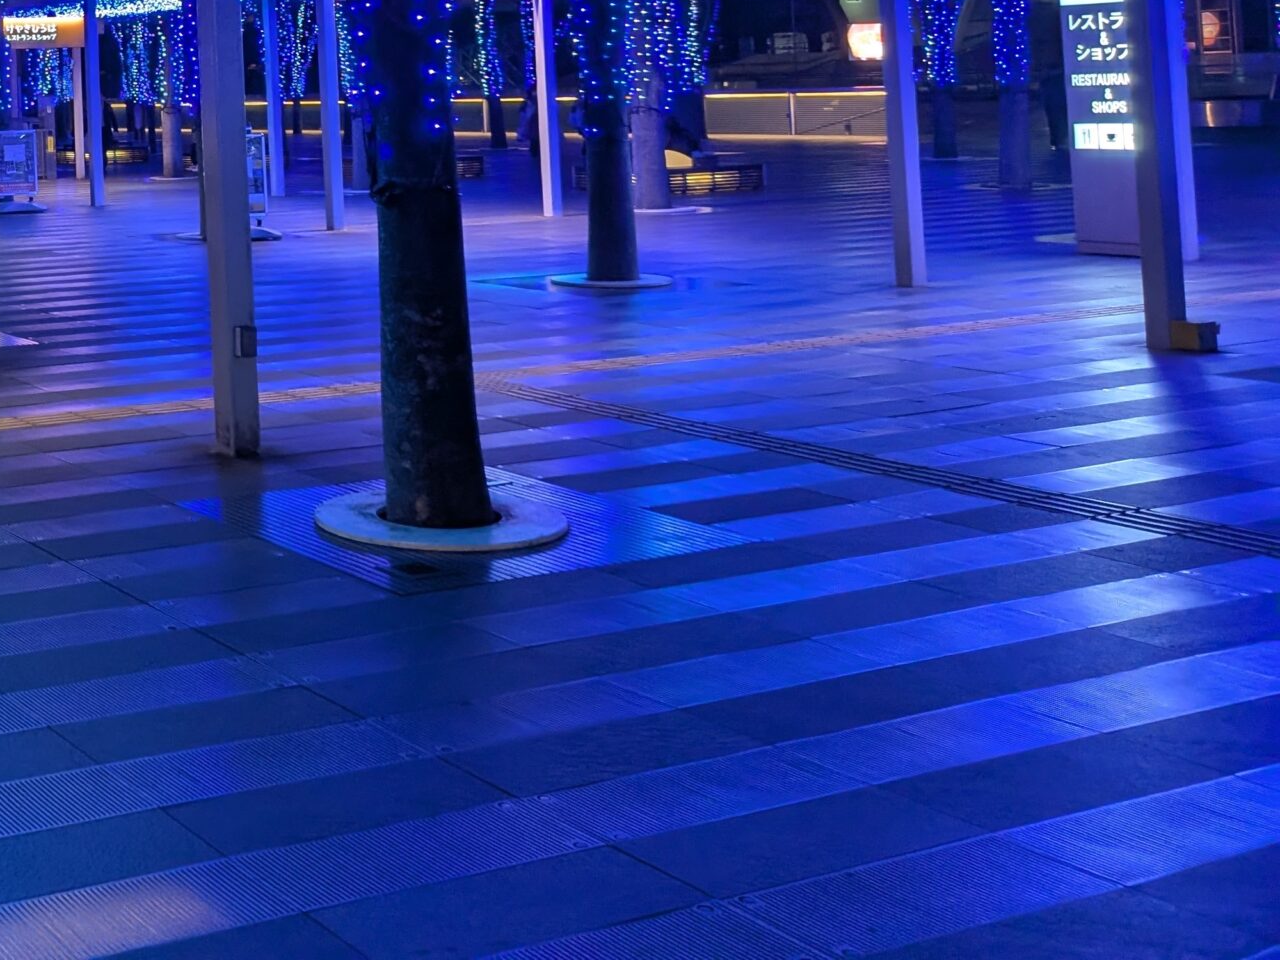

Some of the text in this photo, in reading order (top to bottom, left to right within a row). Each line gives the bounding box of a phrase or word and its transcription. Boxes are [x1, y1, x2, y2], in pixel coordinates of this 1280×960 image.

[1099, 32, 1109, 46] &
[1104, 88, 1113, 100] &
[1091, 101, 1128, 114] SHOPS
